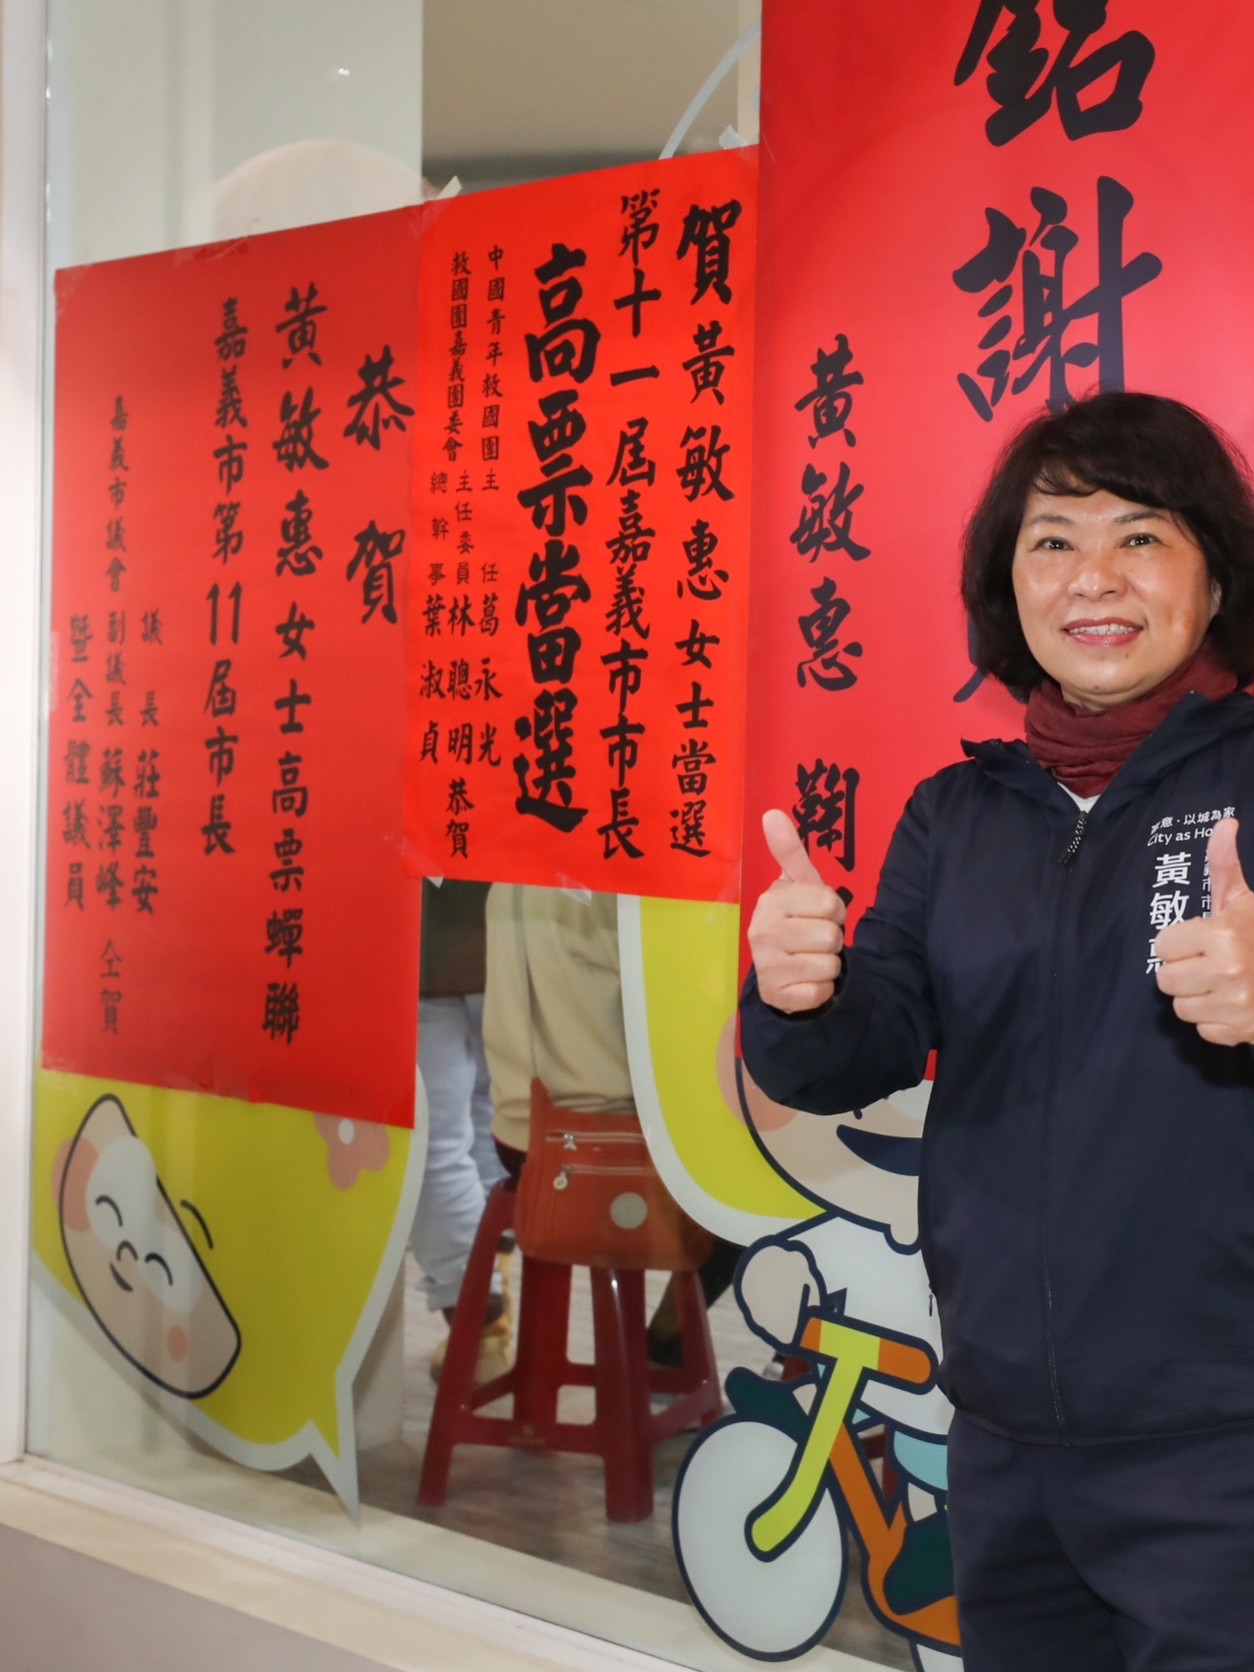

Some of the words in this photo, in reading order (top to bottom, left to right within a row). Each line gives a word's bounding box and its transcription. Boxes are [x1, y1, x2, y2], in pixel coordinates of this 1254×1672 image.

[345, 346, 415, 626] 恭賀
[513, 242, 601, 833] 高票當選
[1175, 831, 1191, 841] as
